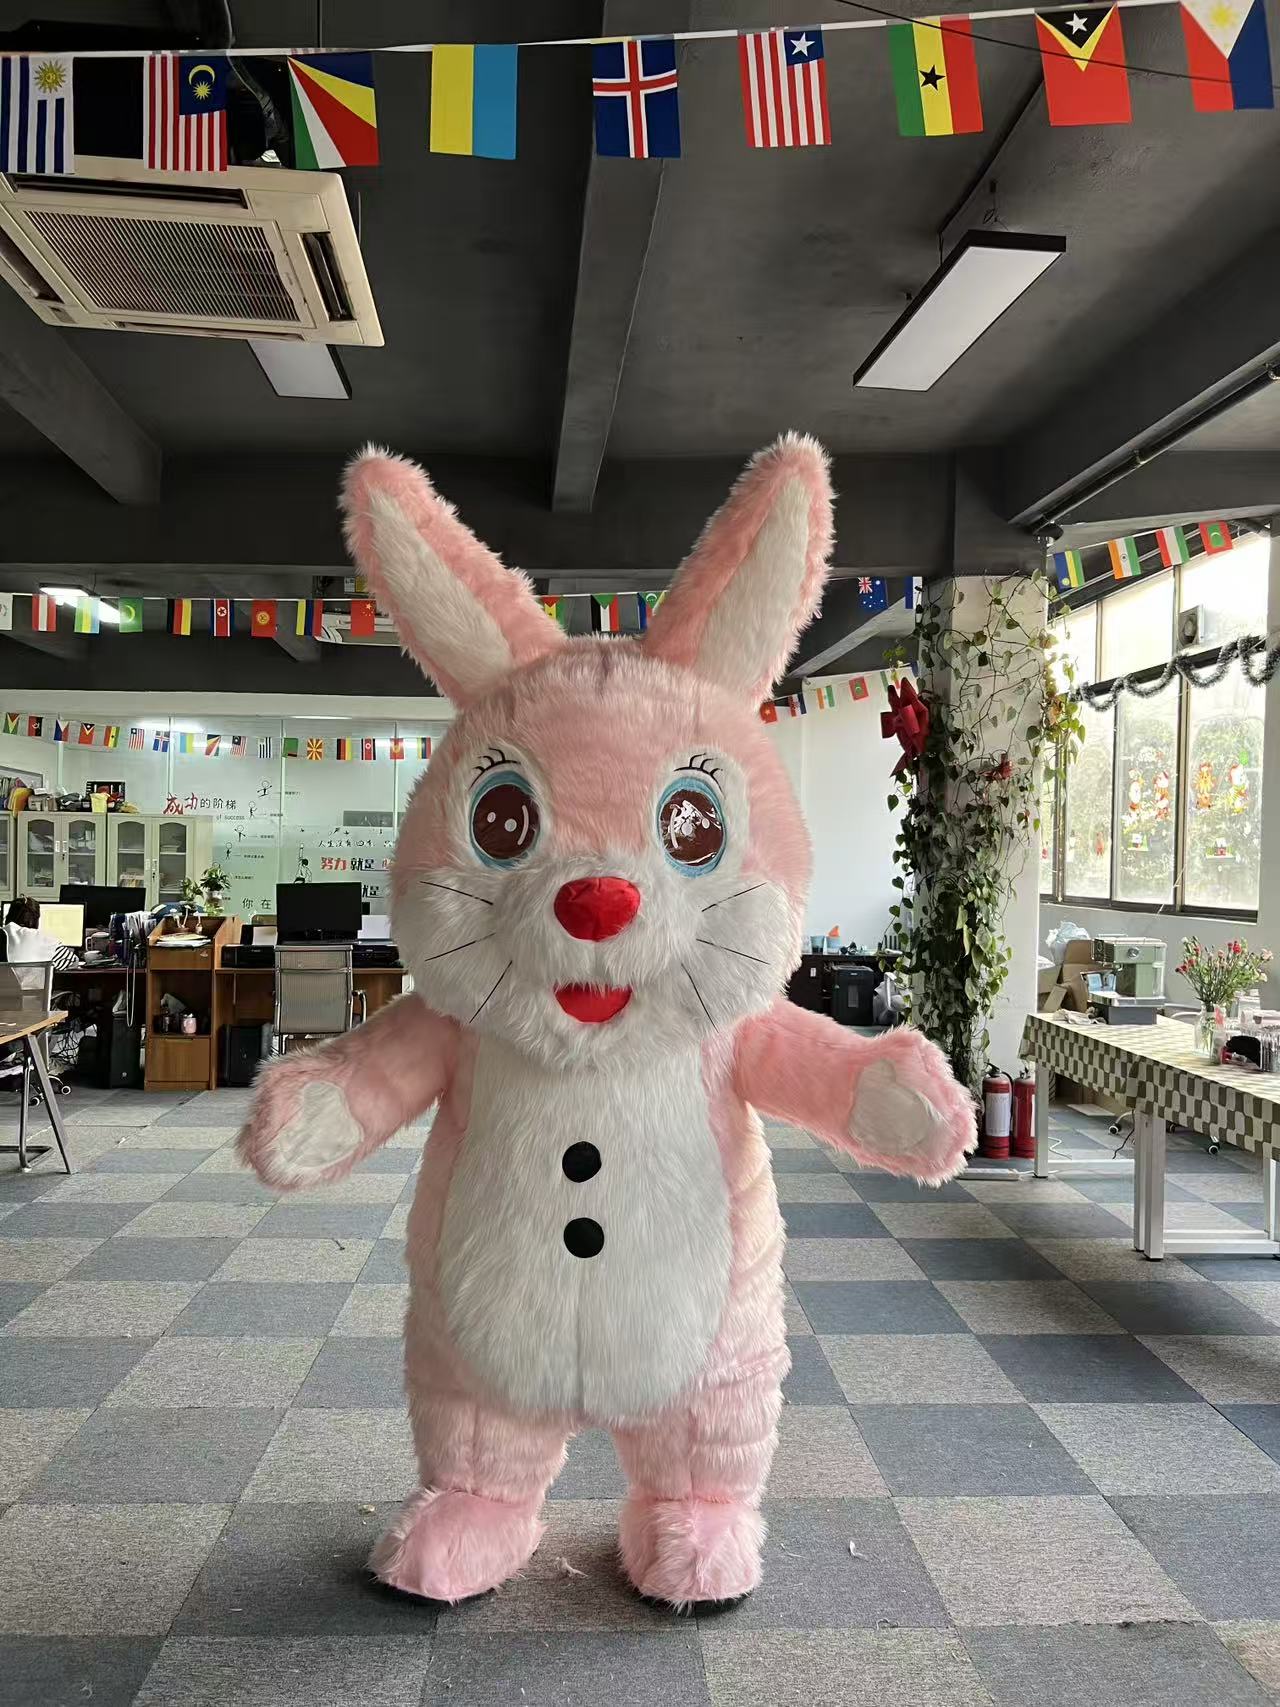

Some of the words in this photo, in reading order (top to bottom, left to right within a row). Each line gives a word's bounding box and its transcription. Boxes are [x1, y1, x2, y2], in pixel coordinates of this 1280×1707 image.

[163, 792, 237, 815] 成功的阶梯
